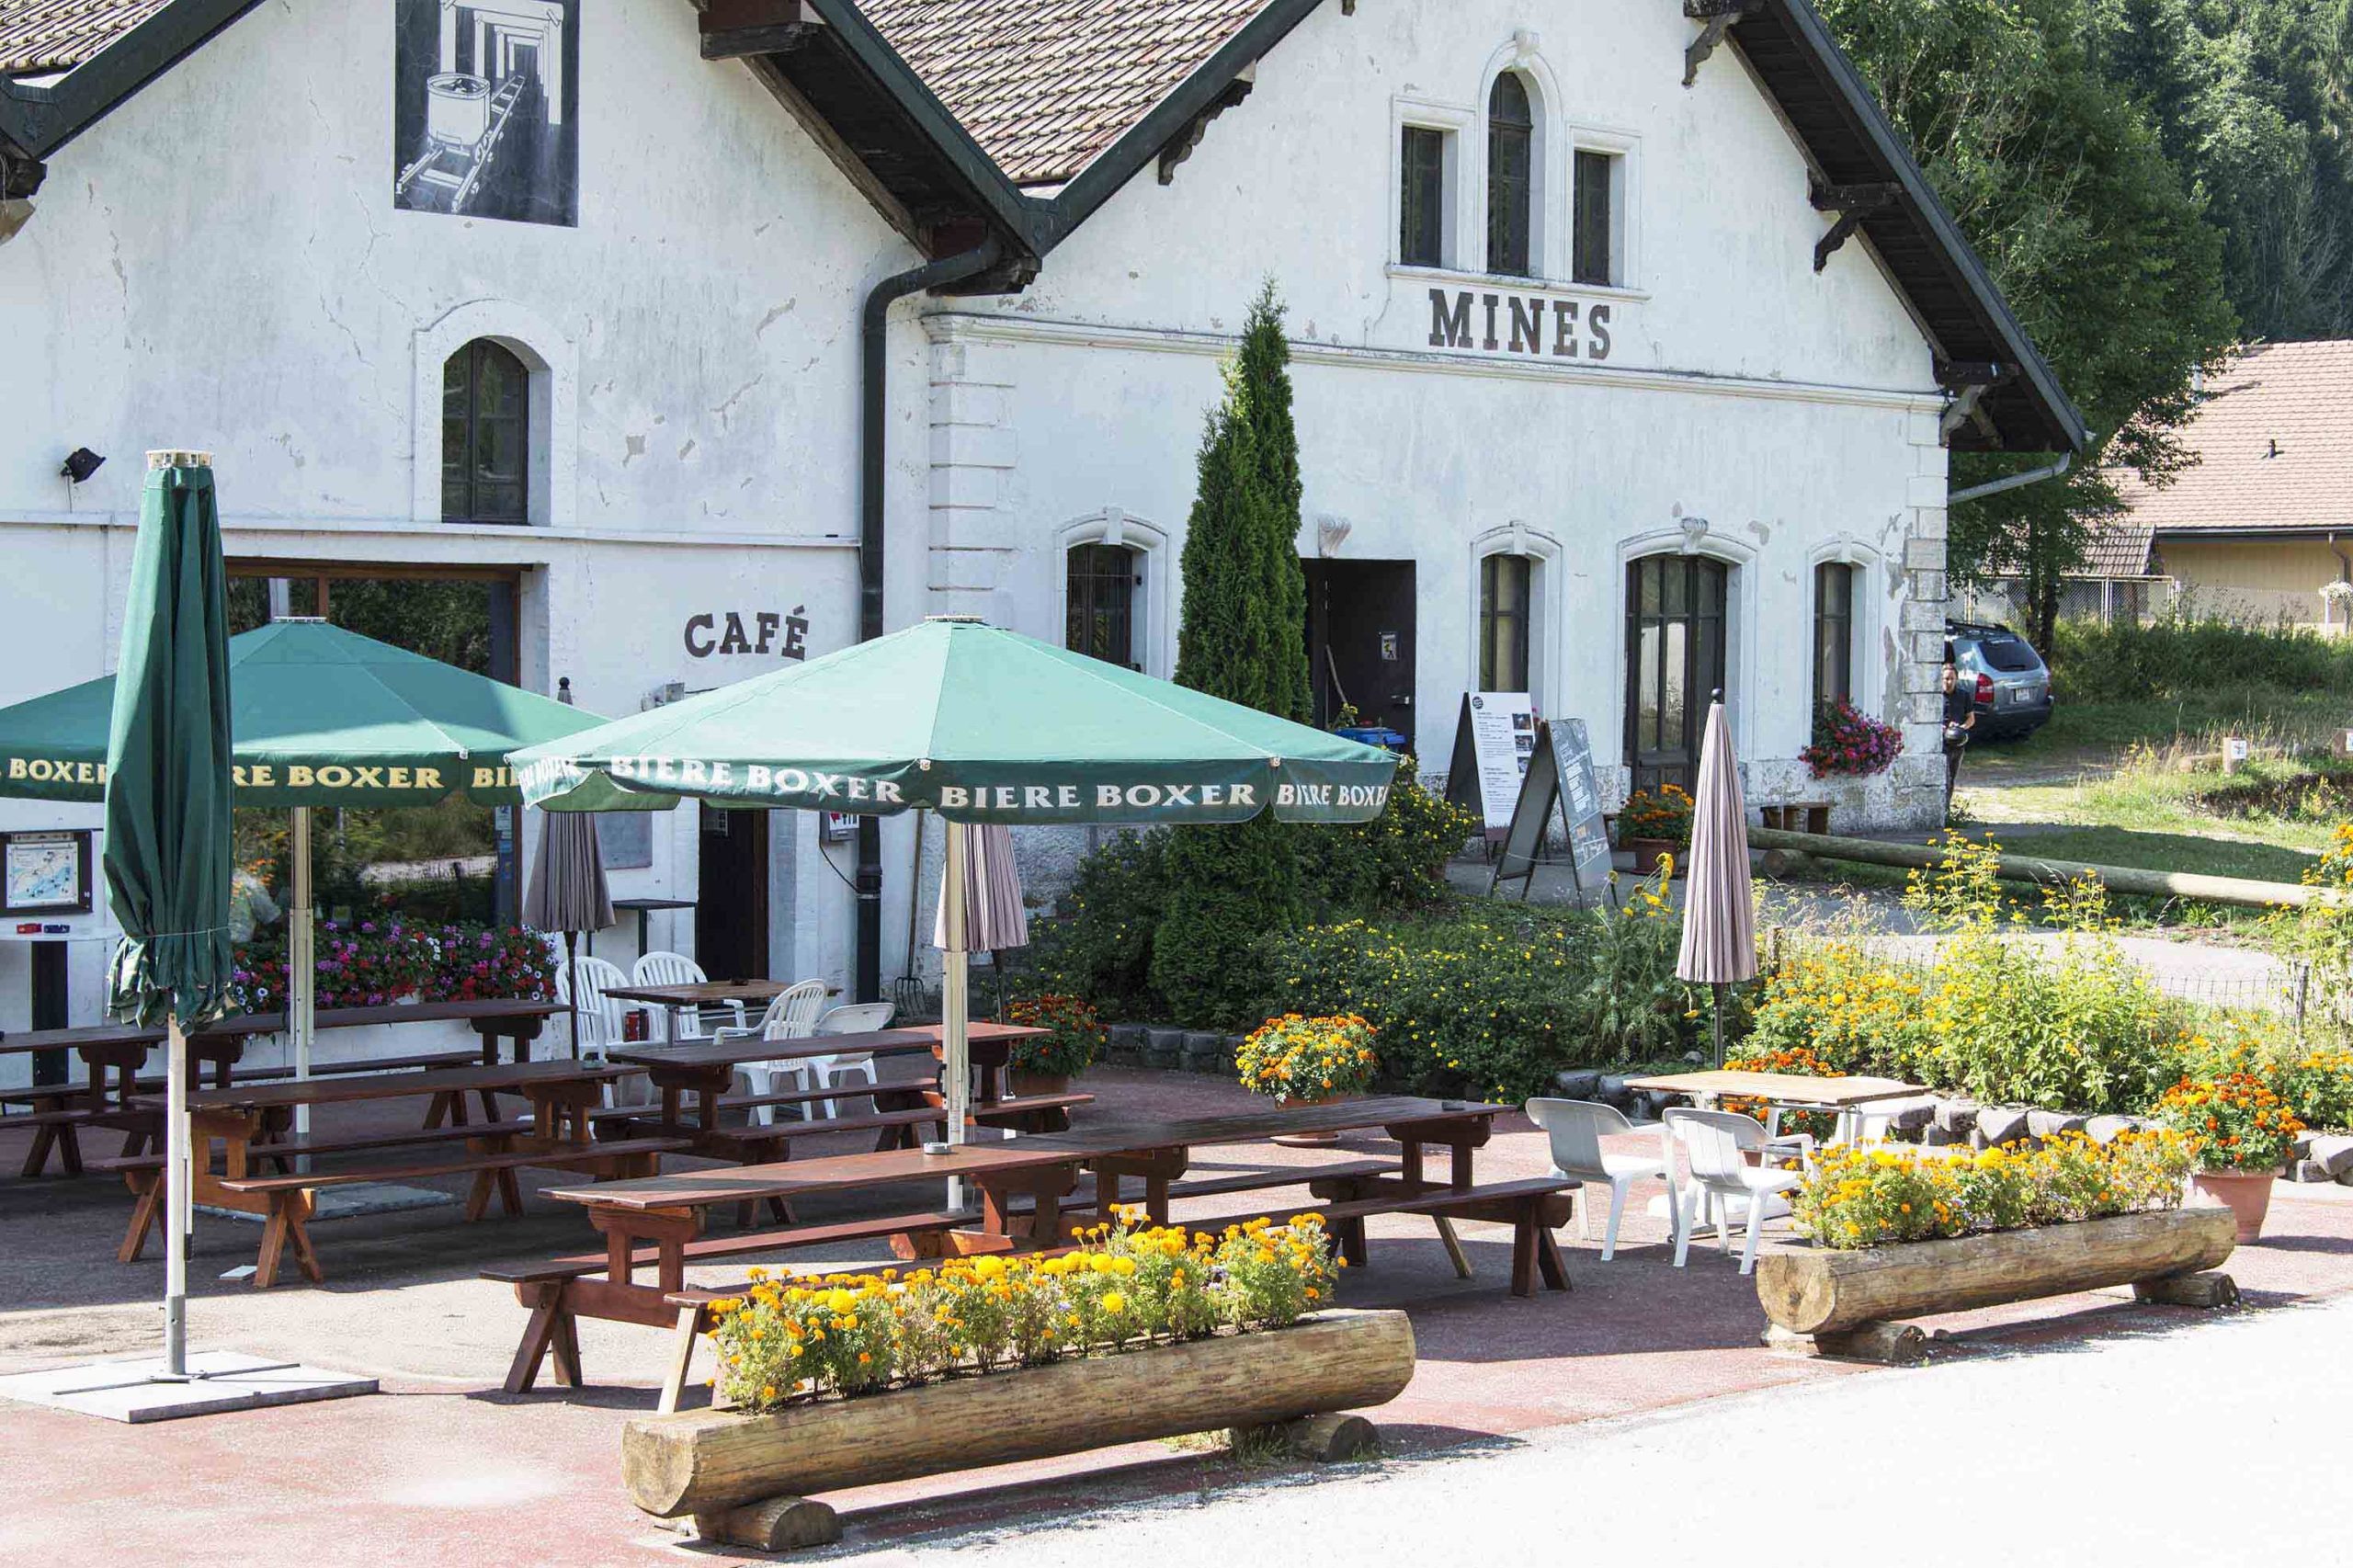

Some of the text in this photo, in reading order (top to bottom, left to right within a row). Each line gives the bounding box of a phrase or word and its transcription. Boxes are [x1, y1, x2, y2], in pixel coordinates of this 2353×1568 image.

[1428, 288, 1611, 360] MINES
[684, 605, 809, 662] CAFÉ
[287, 765, 445, 789] BOXER
[610, 755, 905, 803] BIERE BOXER
[1276, 783, 1333, 806] BIERE
[939, 783, 1256, 809] BIERE BOXER
